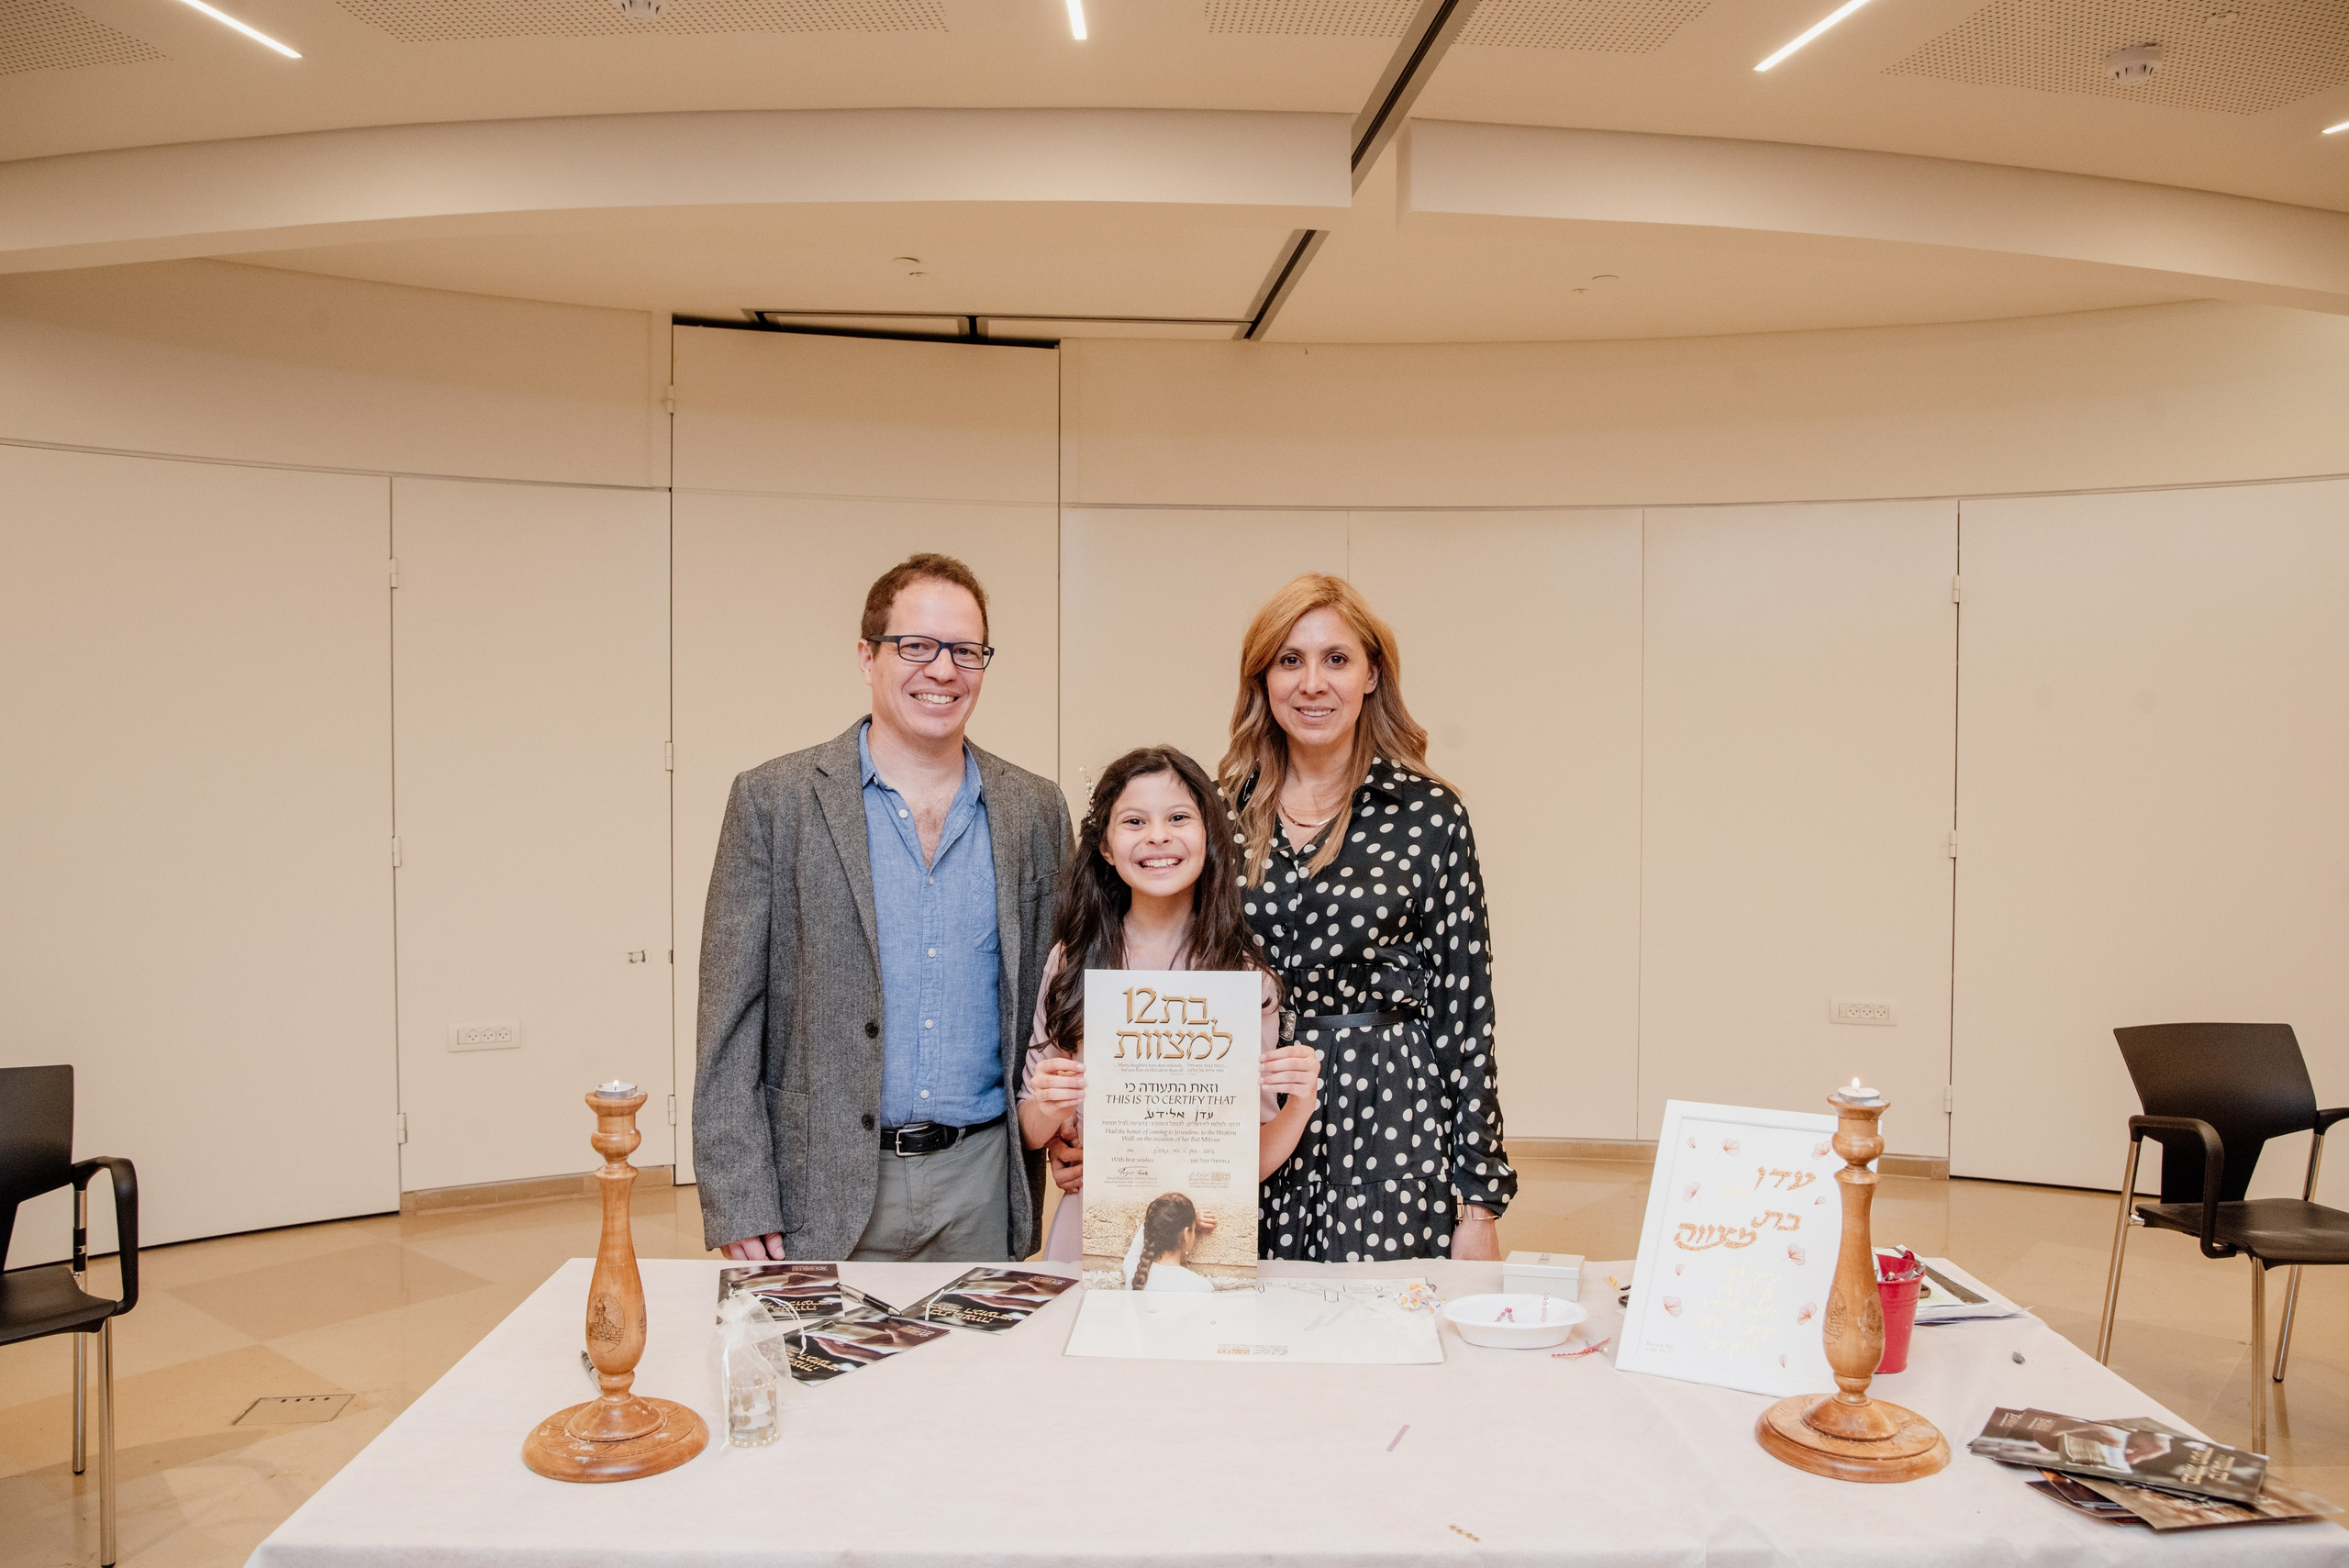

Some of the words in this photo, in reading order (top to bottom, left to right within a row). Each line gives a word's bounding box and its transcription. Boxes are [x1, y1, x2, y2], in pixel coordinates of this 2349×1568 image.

[1114, 1017, 1233, 1060] למצוות
[1124, 1083, 1136, 1093] כי
[1139, 1083, 1186, 1094] התעודה
[1189, 1083, 1219, 1093] וזאת
[1106, 1095, 1130, 1105] THIS
[1132, 1095, 1141, 1105] IS
[1144, 1095, 1160, 1105] TO
[1162, 1095, 1206, 1106] CERTIFY
[1207, 1095, 1237, 1106] THAT
[1195, 1110, 1214, 1122] עדן
[1149, 1129, 1168, 1138] coming
[1754, 1166, 1817, 1191] עדן
[1750, 1209, 1801, 1232] בת
